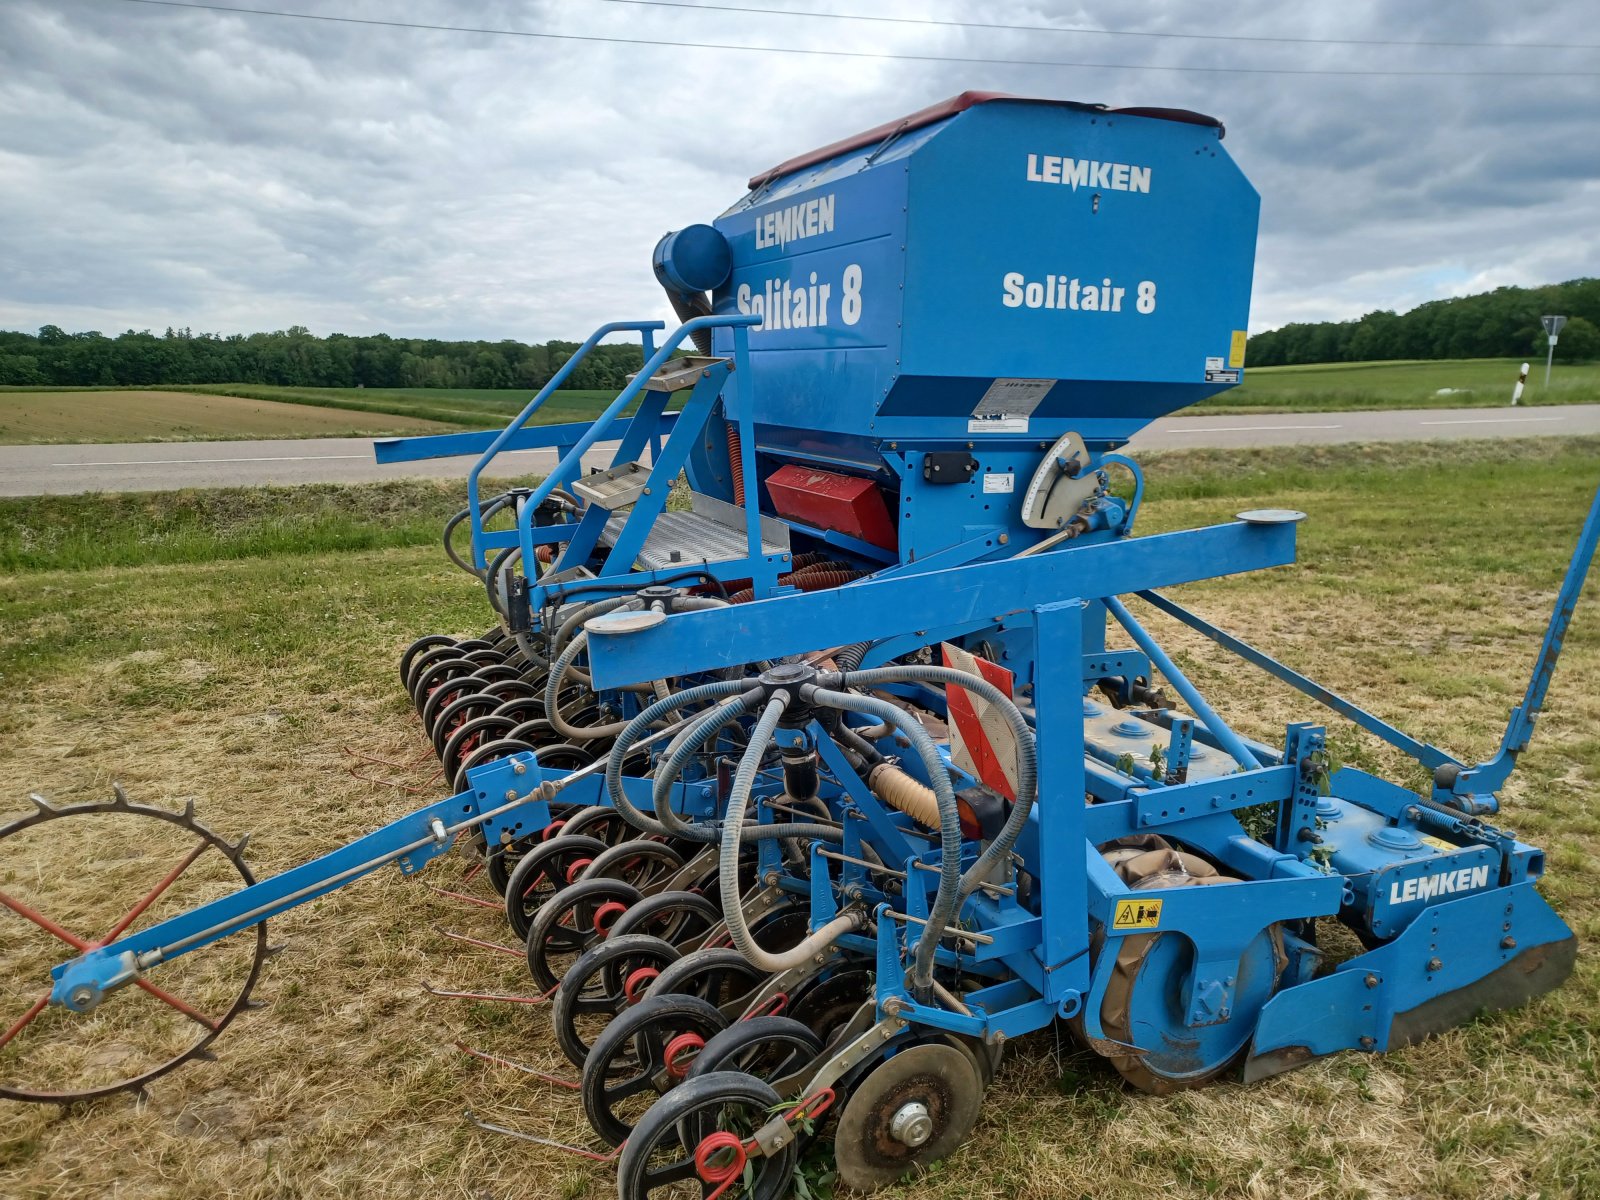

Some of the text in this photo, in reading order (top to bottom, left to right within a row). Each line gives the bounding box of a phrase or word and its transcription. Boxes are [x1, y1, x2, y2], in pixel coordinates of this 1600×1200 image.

[1026, 153, 1152, 194] LEMKEN
[755, 194, 835, 253] LEMKEN
[737, 263, 863, 332] Solitair 8
[1002, 271, 1156, 315] Solitair 8
[1390, 865, 1489, 905] LEMKEN
